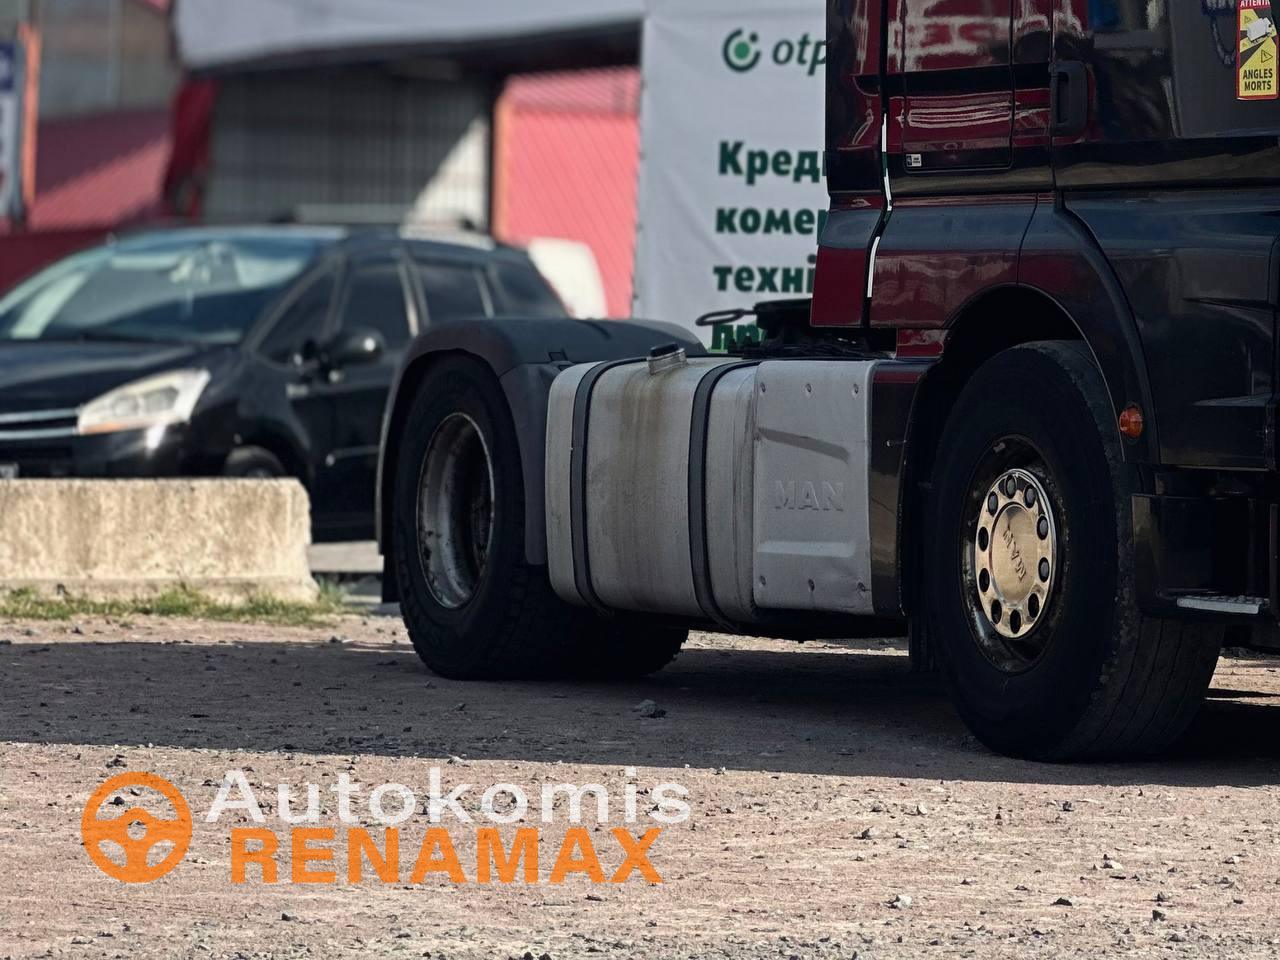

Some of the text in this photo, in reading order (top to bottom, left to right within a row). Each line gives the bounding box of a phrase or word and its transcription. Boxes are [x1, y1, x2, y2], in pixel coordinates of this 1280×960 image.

[1243, 68, 1273, 80] ANGLES
[1244, 80, 1272, 91] MORTS
[719, 141, 827, 185] Кред
[774, 480, 846, 512] MAN
